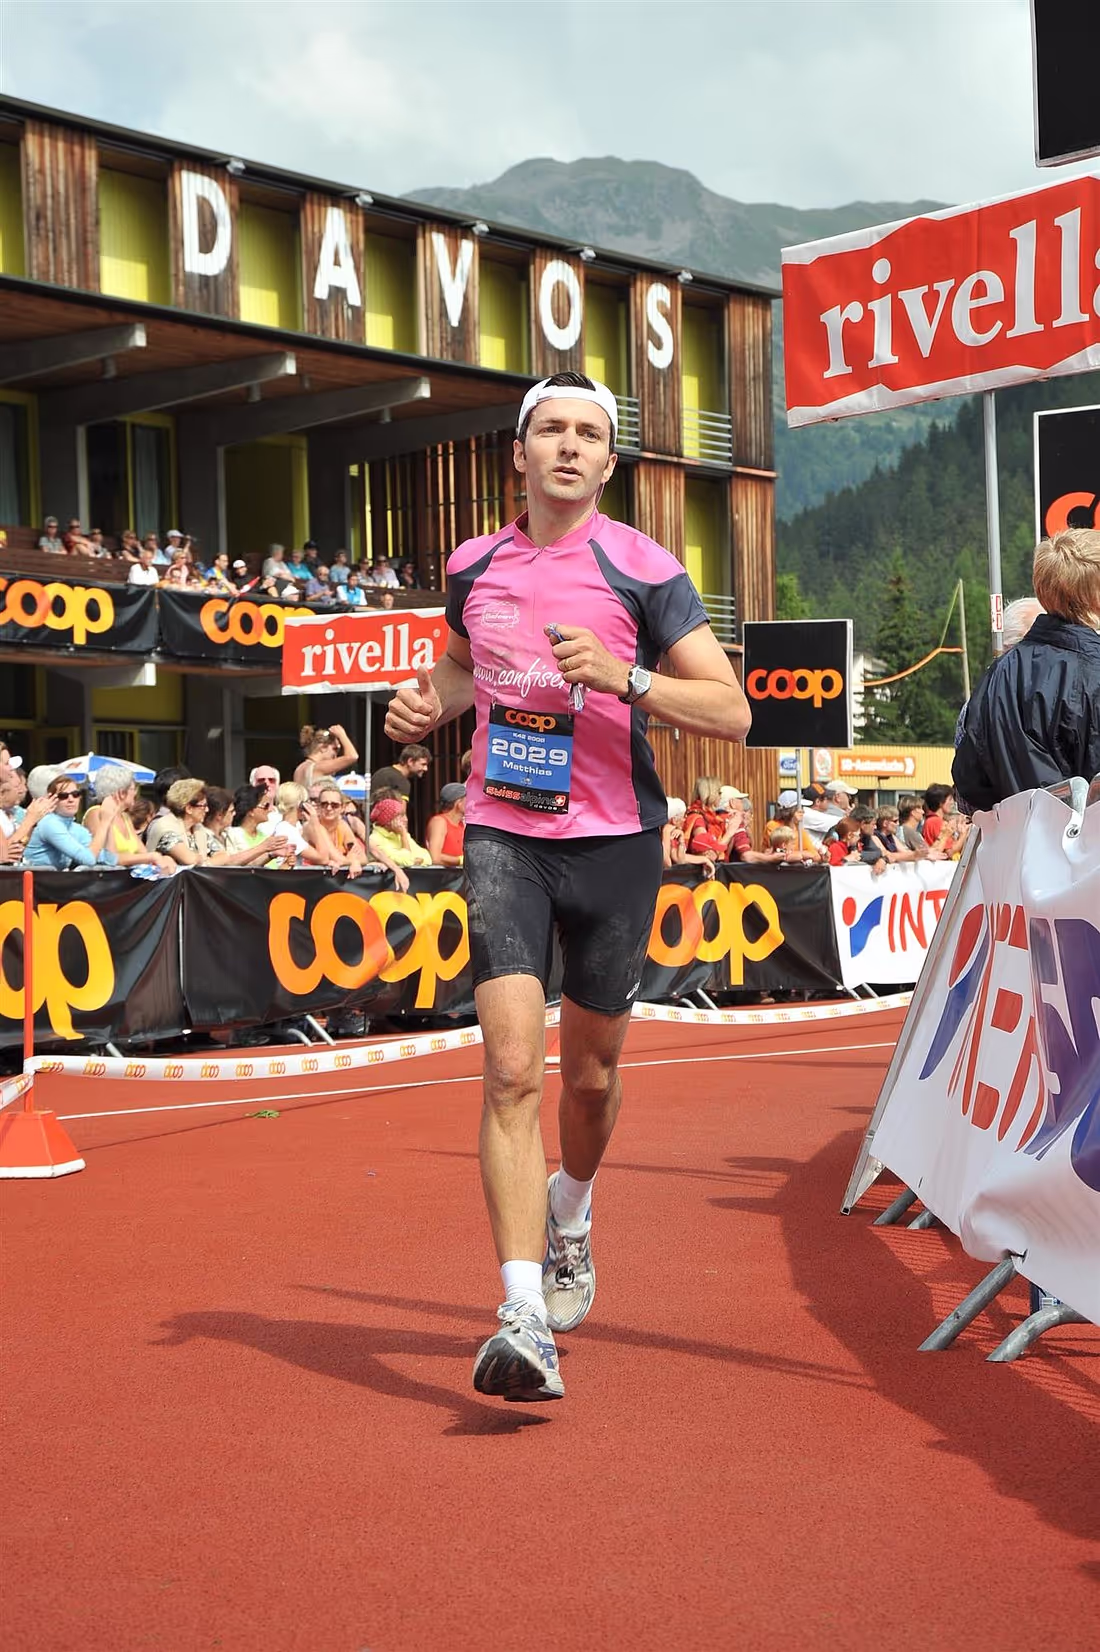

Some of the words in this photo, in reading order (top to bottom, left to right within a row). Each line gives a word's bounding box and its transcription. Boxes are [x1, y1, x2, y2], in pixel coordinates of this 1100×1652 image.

[180, 169, 674, 370] DAVOS
[820, 206, 1100, 380] rivell
[200, 598, 316, 648] coo
[746, 668, 843, 708] coop
[505, 709, 557, 733] coop
[491, 738, 568, 766] 2029
[503, 760, 553, 776] Matthias
[269, 891, 470, 1009] coop
